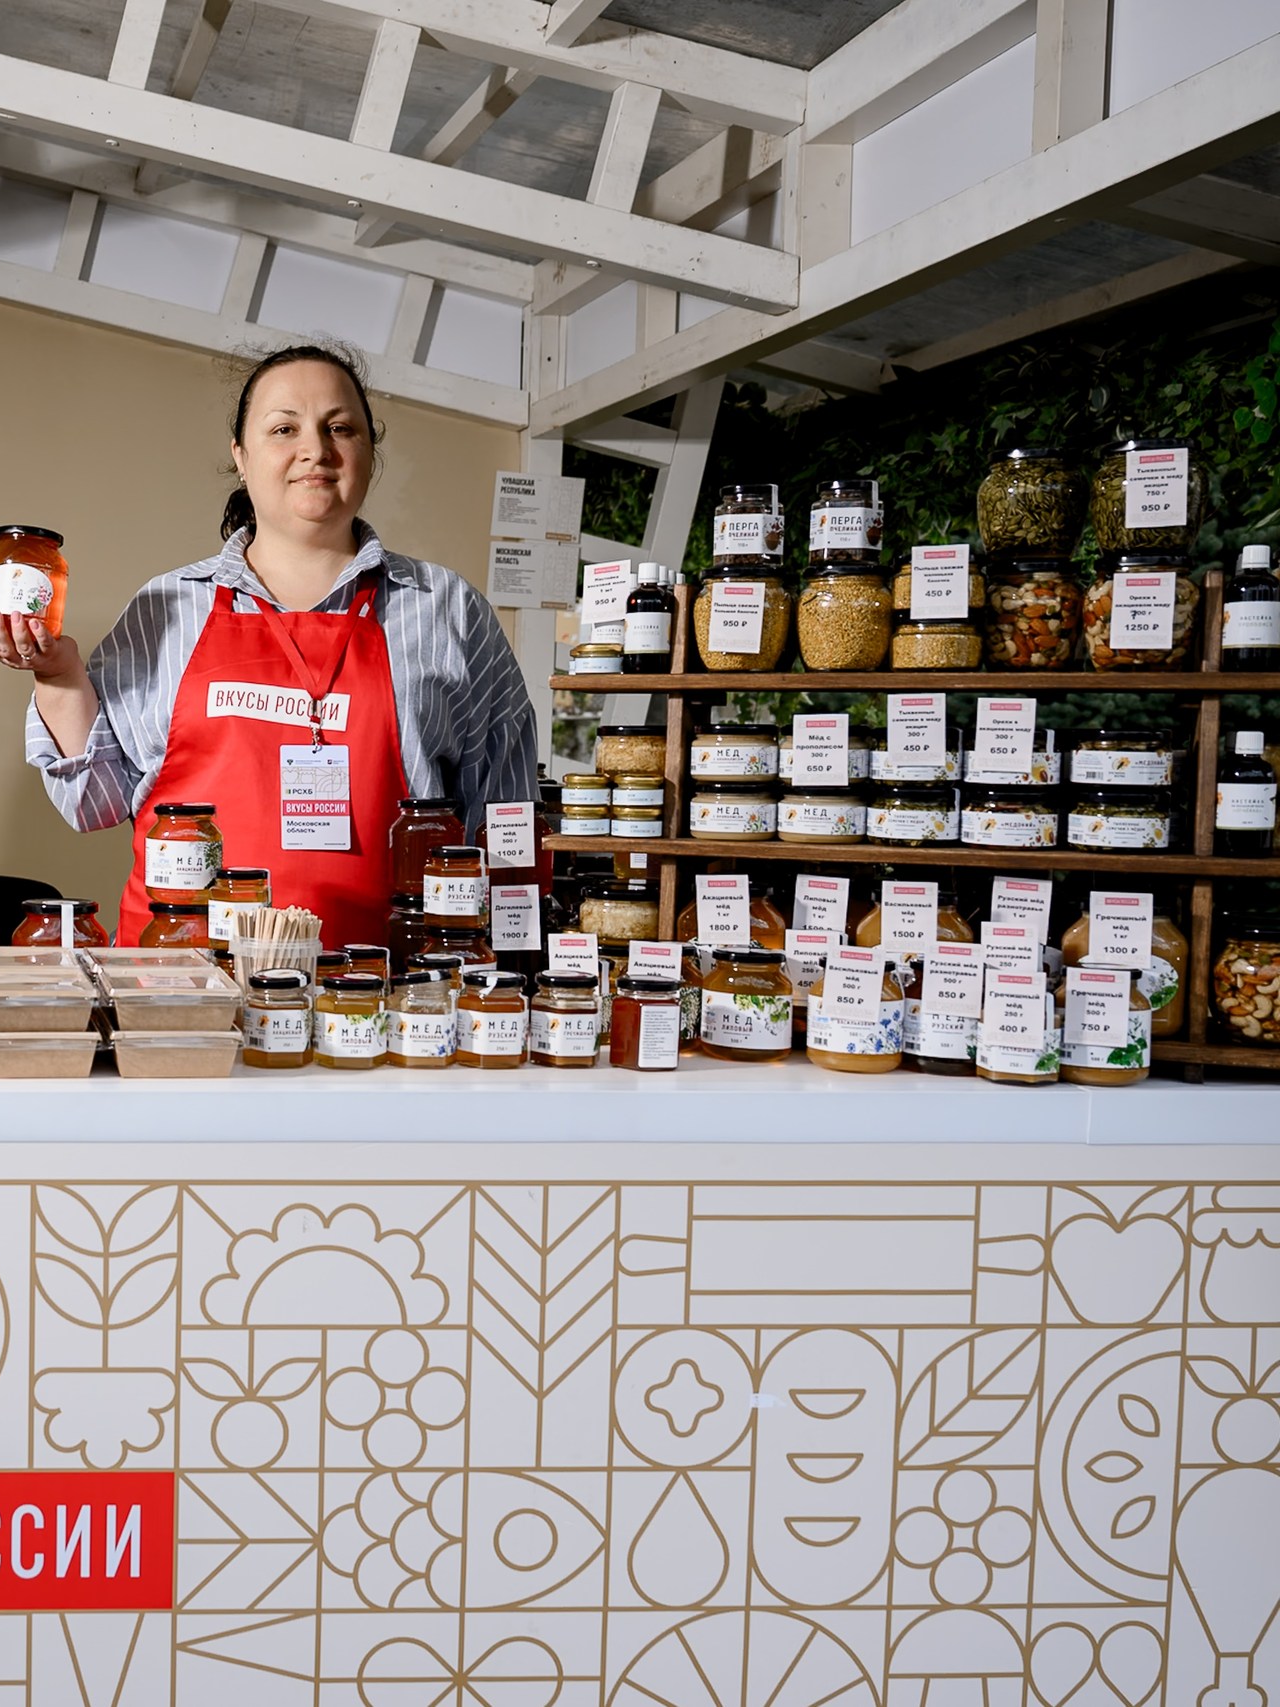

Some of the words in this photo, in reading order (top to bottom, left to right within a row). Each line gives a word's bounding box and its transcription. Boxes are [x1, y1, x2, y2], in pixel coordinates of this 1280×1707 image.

[501, 486, 535, 496] РЕСПУБЛИКА
[1141, 504, 1160, 512] 950
[831, 516, 864, 525] ПЕРГА
[729, 522, 759, 531] ПЕРГА
[496, 548, 531, 556] МОСКОВСКАЯ
[495, 557, 519, 565] ОБЛАСТЬ
[215, 690, 269, 712] ВКУСЫ
[286, 803, 313, 814] ВКУСЫ
[314, 803, 346, 813] РОССИИ
[177, 857, 203, 866] МЁД
[448, 883, 476, 895] МЁД
[804, 895, 837, 903] Липовый
[829, 965, 878, 974] Васильковый
[989, 991, 1040, 999] Гречишный
[1071, 990, 1123, 998] Гречишный
[837, 996, 854, 1004] 850
[273, 1019, 302, 1029] МЁД
[723, 1014, 752, 1026] МЁД
[412, 1022, 442, 1034] МЁД
[489, 1020, 517, 1031] МЁД
[565, 1020, 594, 1031] МЁД
[1081, 1023, 1100, 1031] 750
[342, 1027, 373, 1037] МЁД
